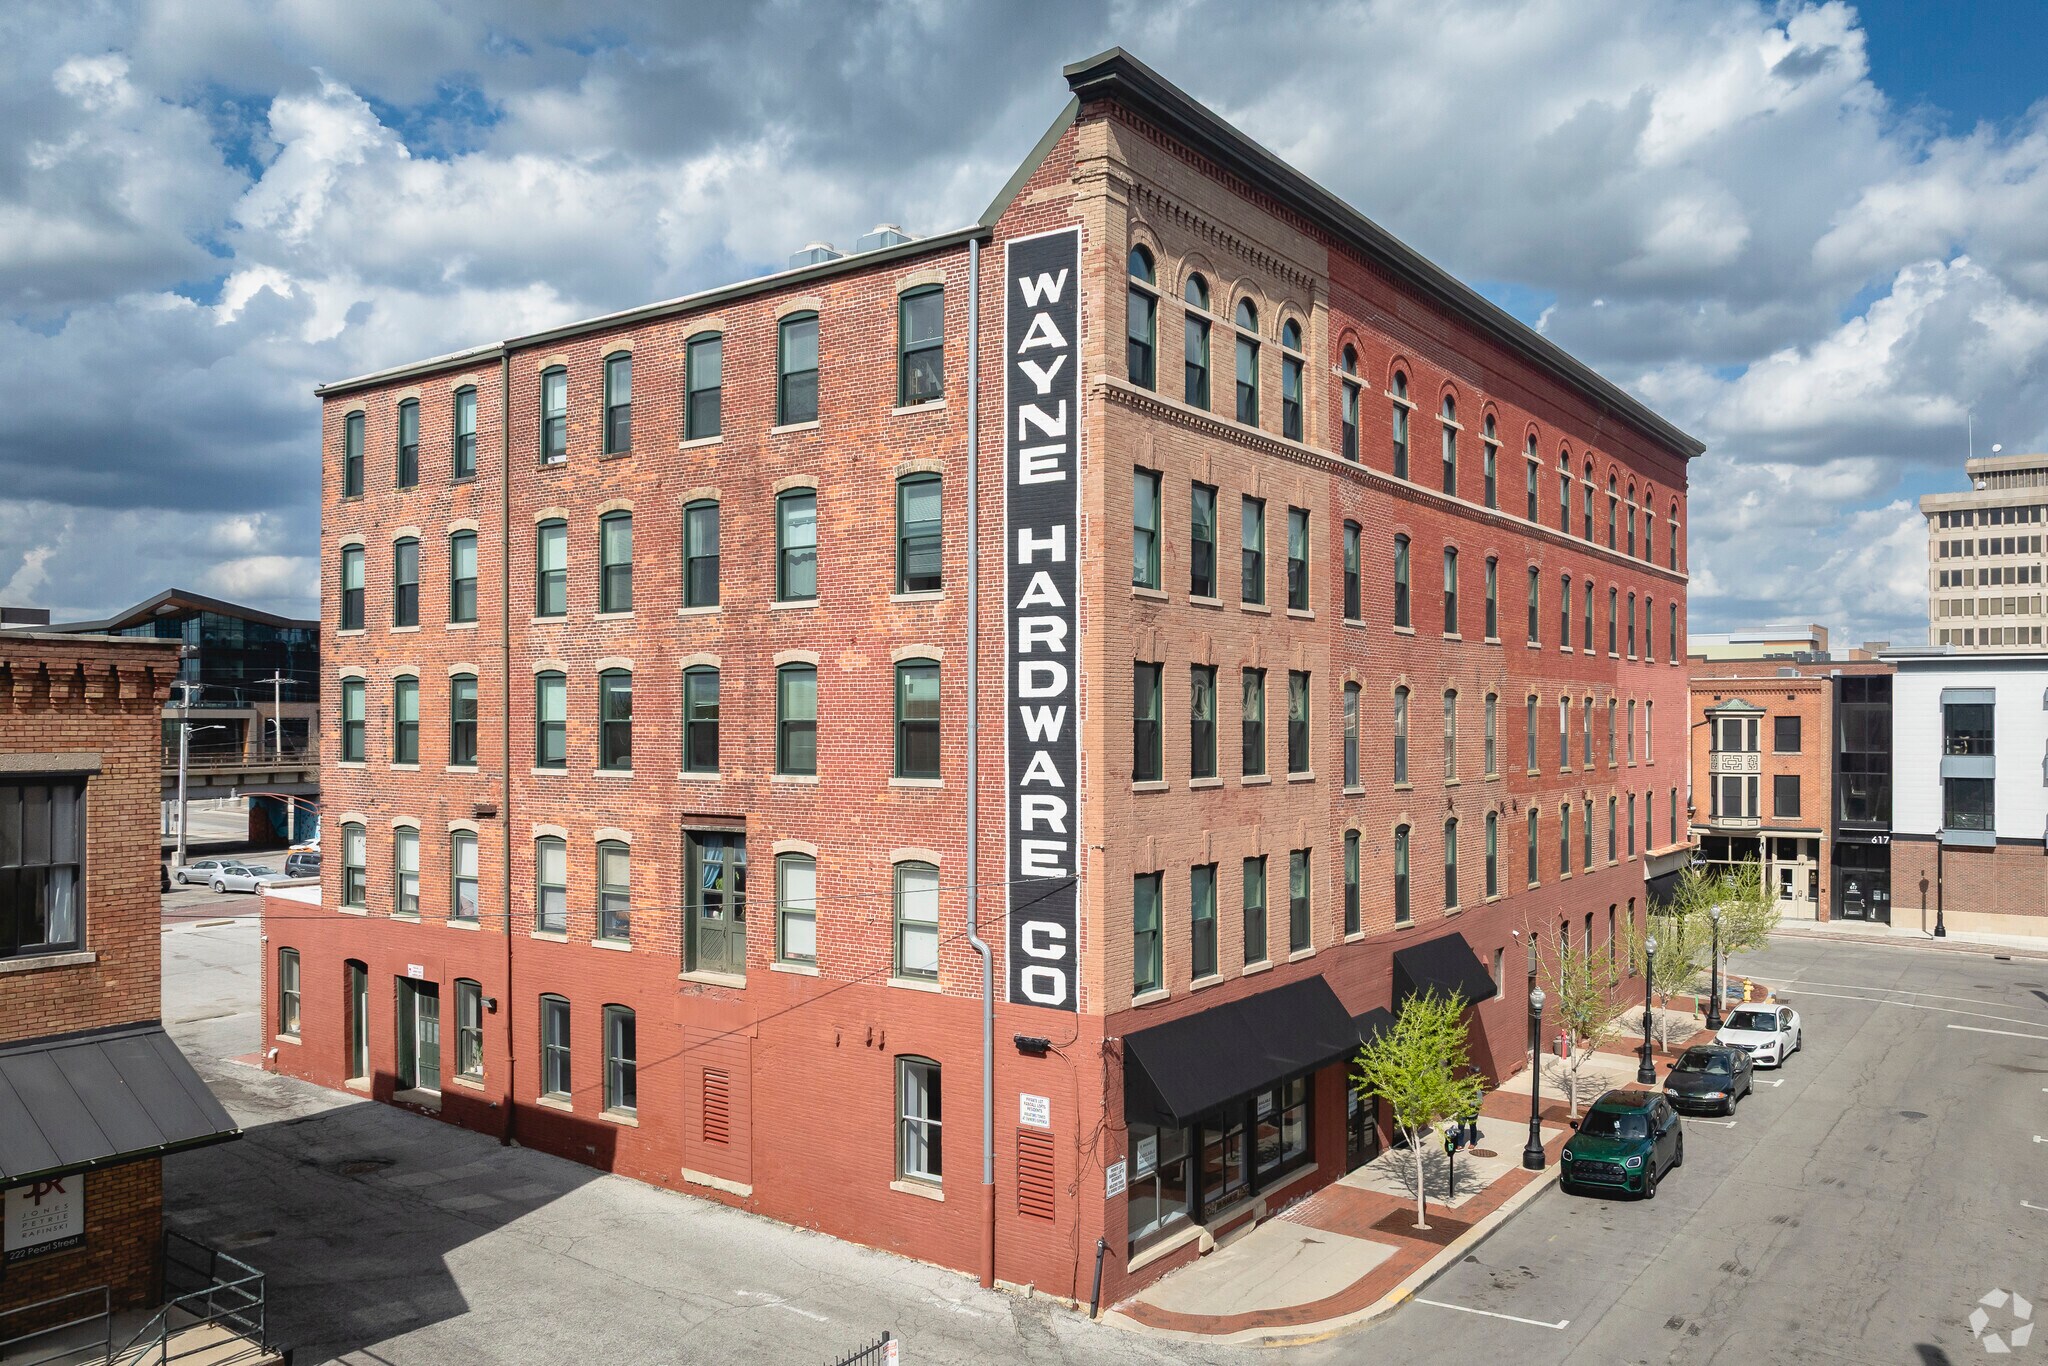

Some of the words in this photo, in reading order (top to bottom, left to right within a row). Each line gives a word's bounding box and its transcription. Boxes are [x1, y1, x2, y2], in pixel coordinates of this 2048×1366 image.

[1018, 268, 1068, 485] WAYNE
[1017, 525, 1068, 877] HARDWARE
[1871, 836, 1890, 844] 617
[1021, 920, 1067, 1005] CO
[22, 1203, 69, 1219] JONES
[22, 1213, 68, 1228] PETRIE
[22, 1223, 68, 1238] RAFINSKI
[10, 1250, 26, 1260] 222
[28, 1243, 51, 1255] Pearl
[53, 1237, 78, 1250] Street
